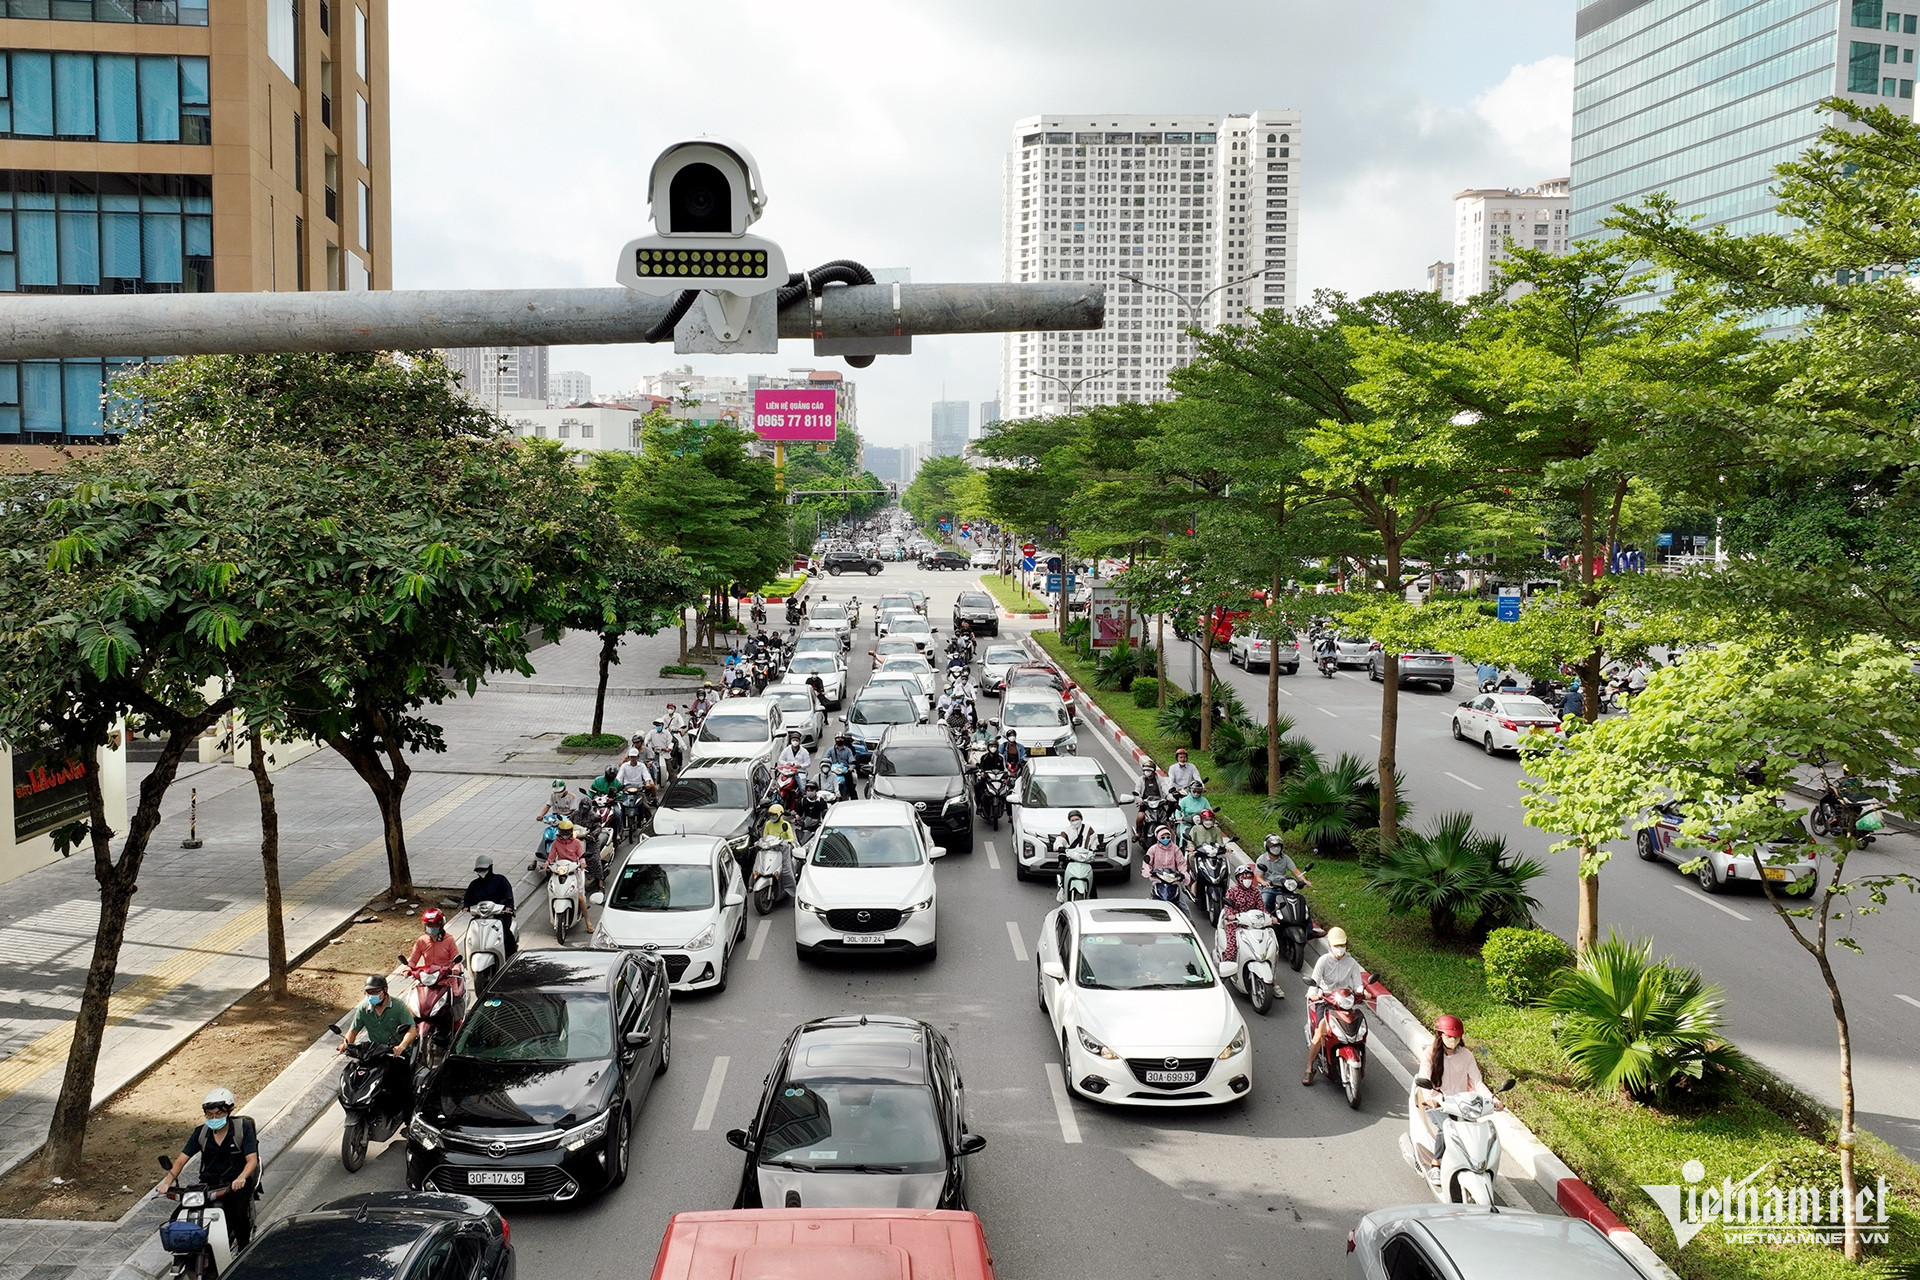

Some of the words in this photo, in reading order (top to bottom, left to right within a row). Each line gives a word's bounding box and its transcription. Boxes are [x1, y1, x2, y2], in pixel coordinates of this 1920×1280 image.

[765, 401, 779, 410] LIÊN
[781, 402, 789, 411] HỆ
[790, 400, 810, 410] QUẢNG
[811, 401, 824, 410] CÁO
[757, 414, 784, 427] 0965
[787, 414, 801, 427] 77
[804, 414, 832, 427] 8118
[1147, 1072, 1194, 1082] 30A-699.92
[469, 1173, 524, 1184] 30F-174.95
